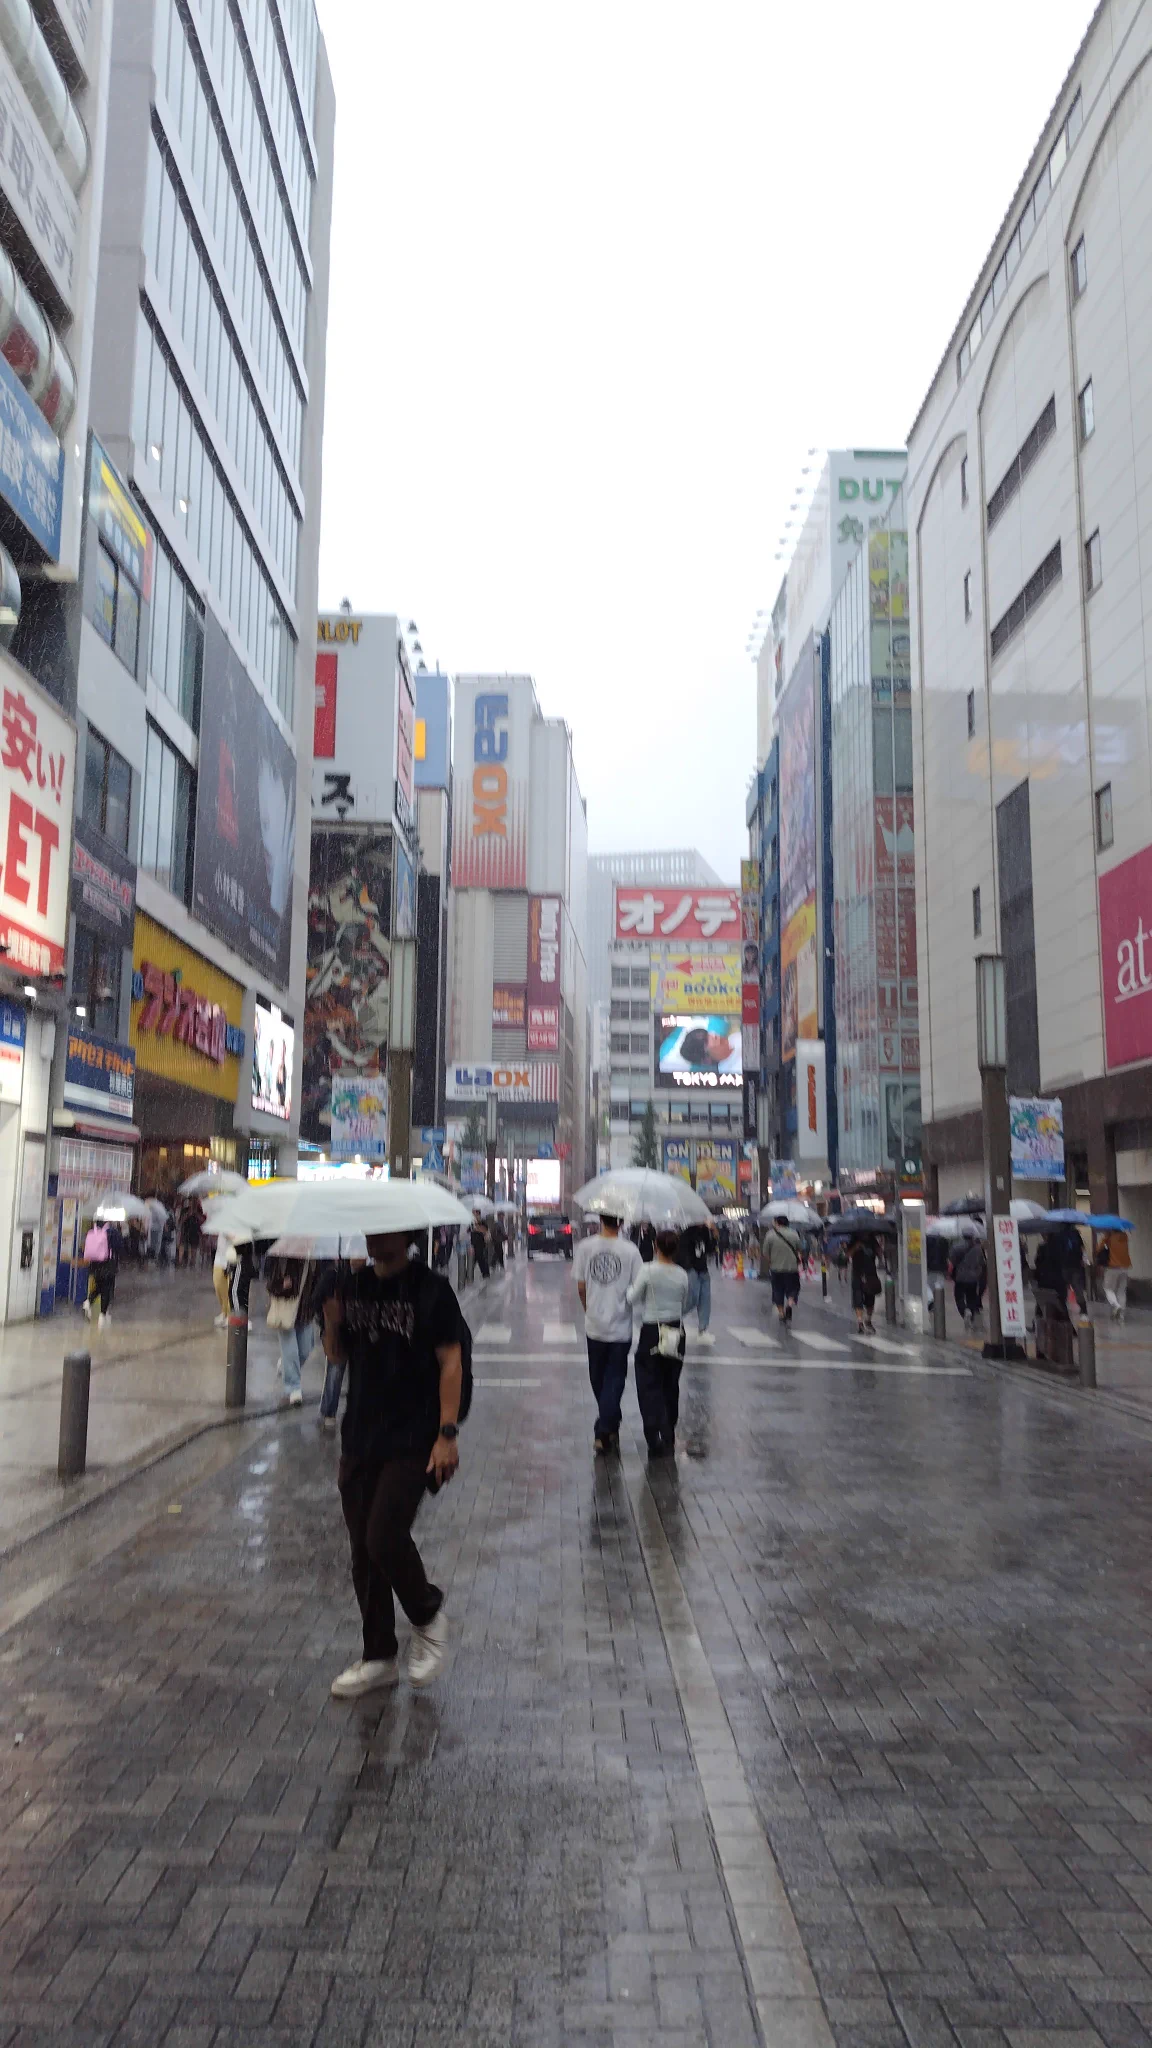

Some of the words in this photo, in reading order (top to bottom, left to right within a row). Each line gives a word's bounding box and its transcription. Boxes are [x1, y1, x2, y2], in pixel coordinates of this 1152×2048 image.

[618, 891, 741, 937] オノデ
[667, 1142, 732, 1160] ONDEN
